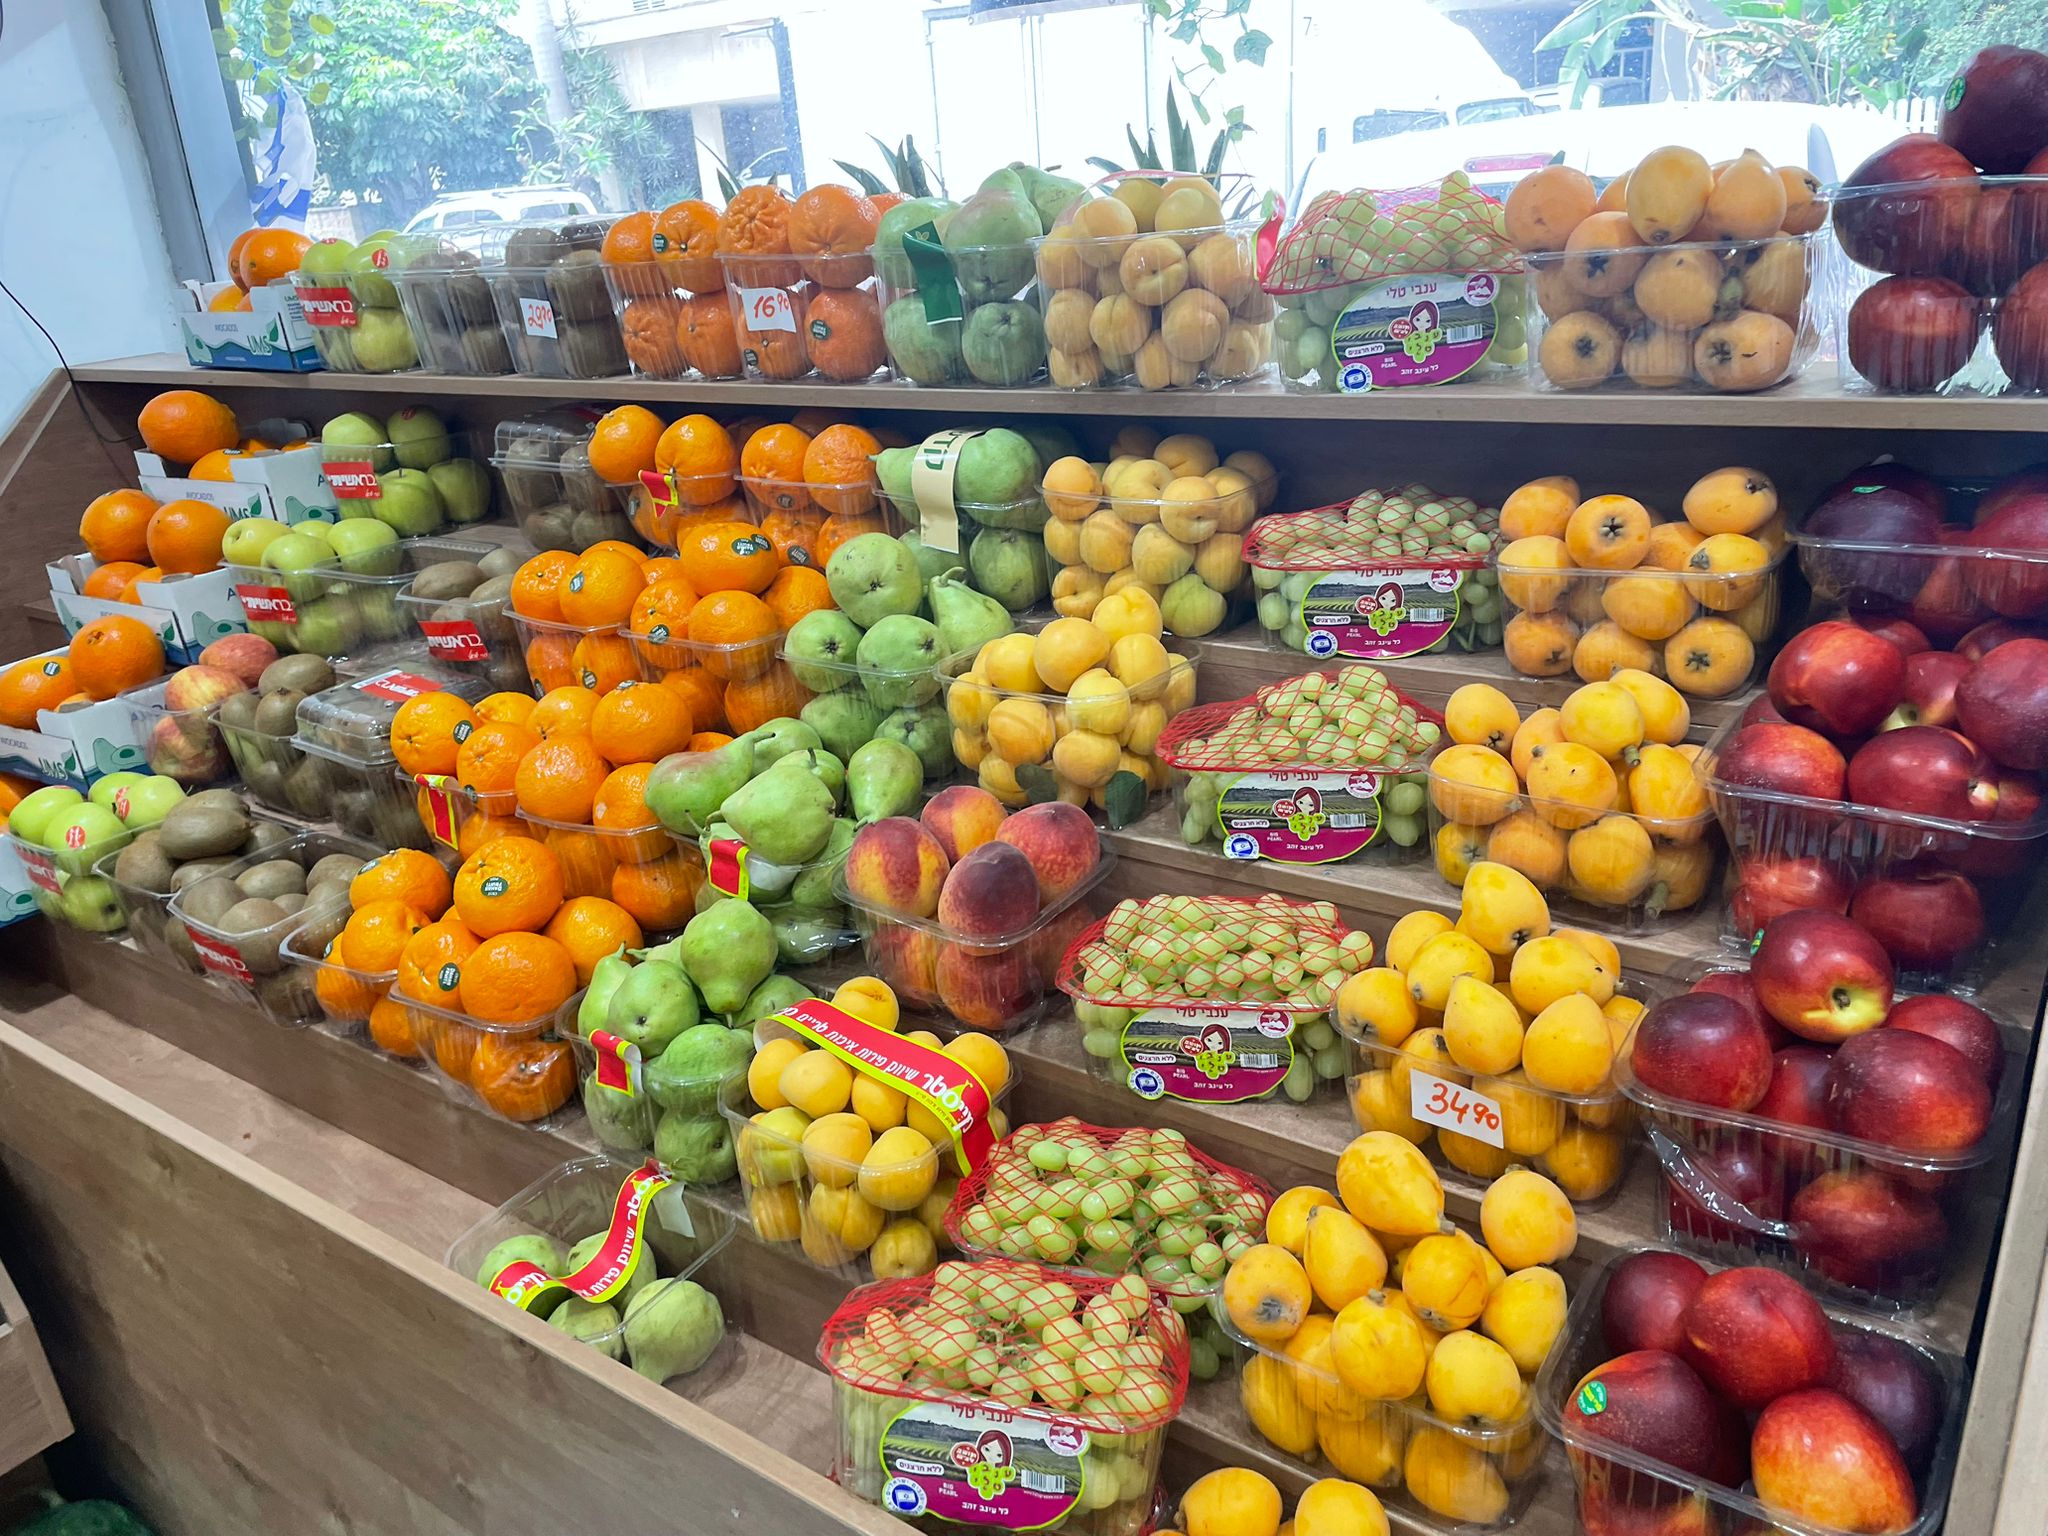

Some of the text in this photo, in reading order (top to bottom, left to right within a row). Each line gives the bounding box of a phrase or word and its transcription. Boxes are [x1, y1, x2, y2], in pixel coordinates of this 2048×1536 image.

[1386, 282, 1437, 299] ענבי טלי
[247, 335, 271, 354] UMS
[38, 757, 67, 780] UMS
[796, 1013, 829, 1036] טריים
[824, 1028, 859, 1054] איכות
[854, 1045, 889, 1067] פירות
[1425, 1082, 1500, 1131] 3490
[591, 1266, 621, 1297] פירות
[950, 1405, 1013, 1423] ענבי טלי
